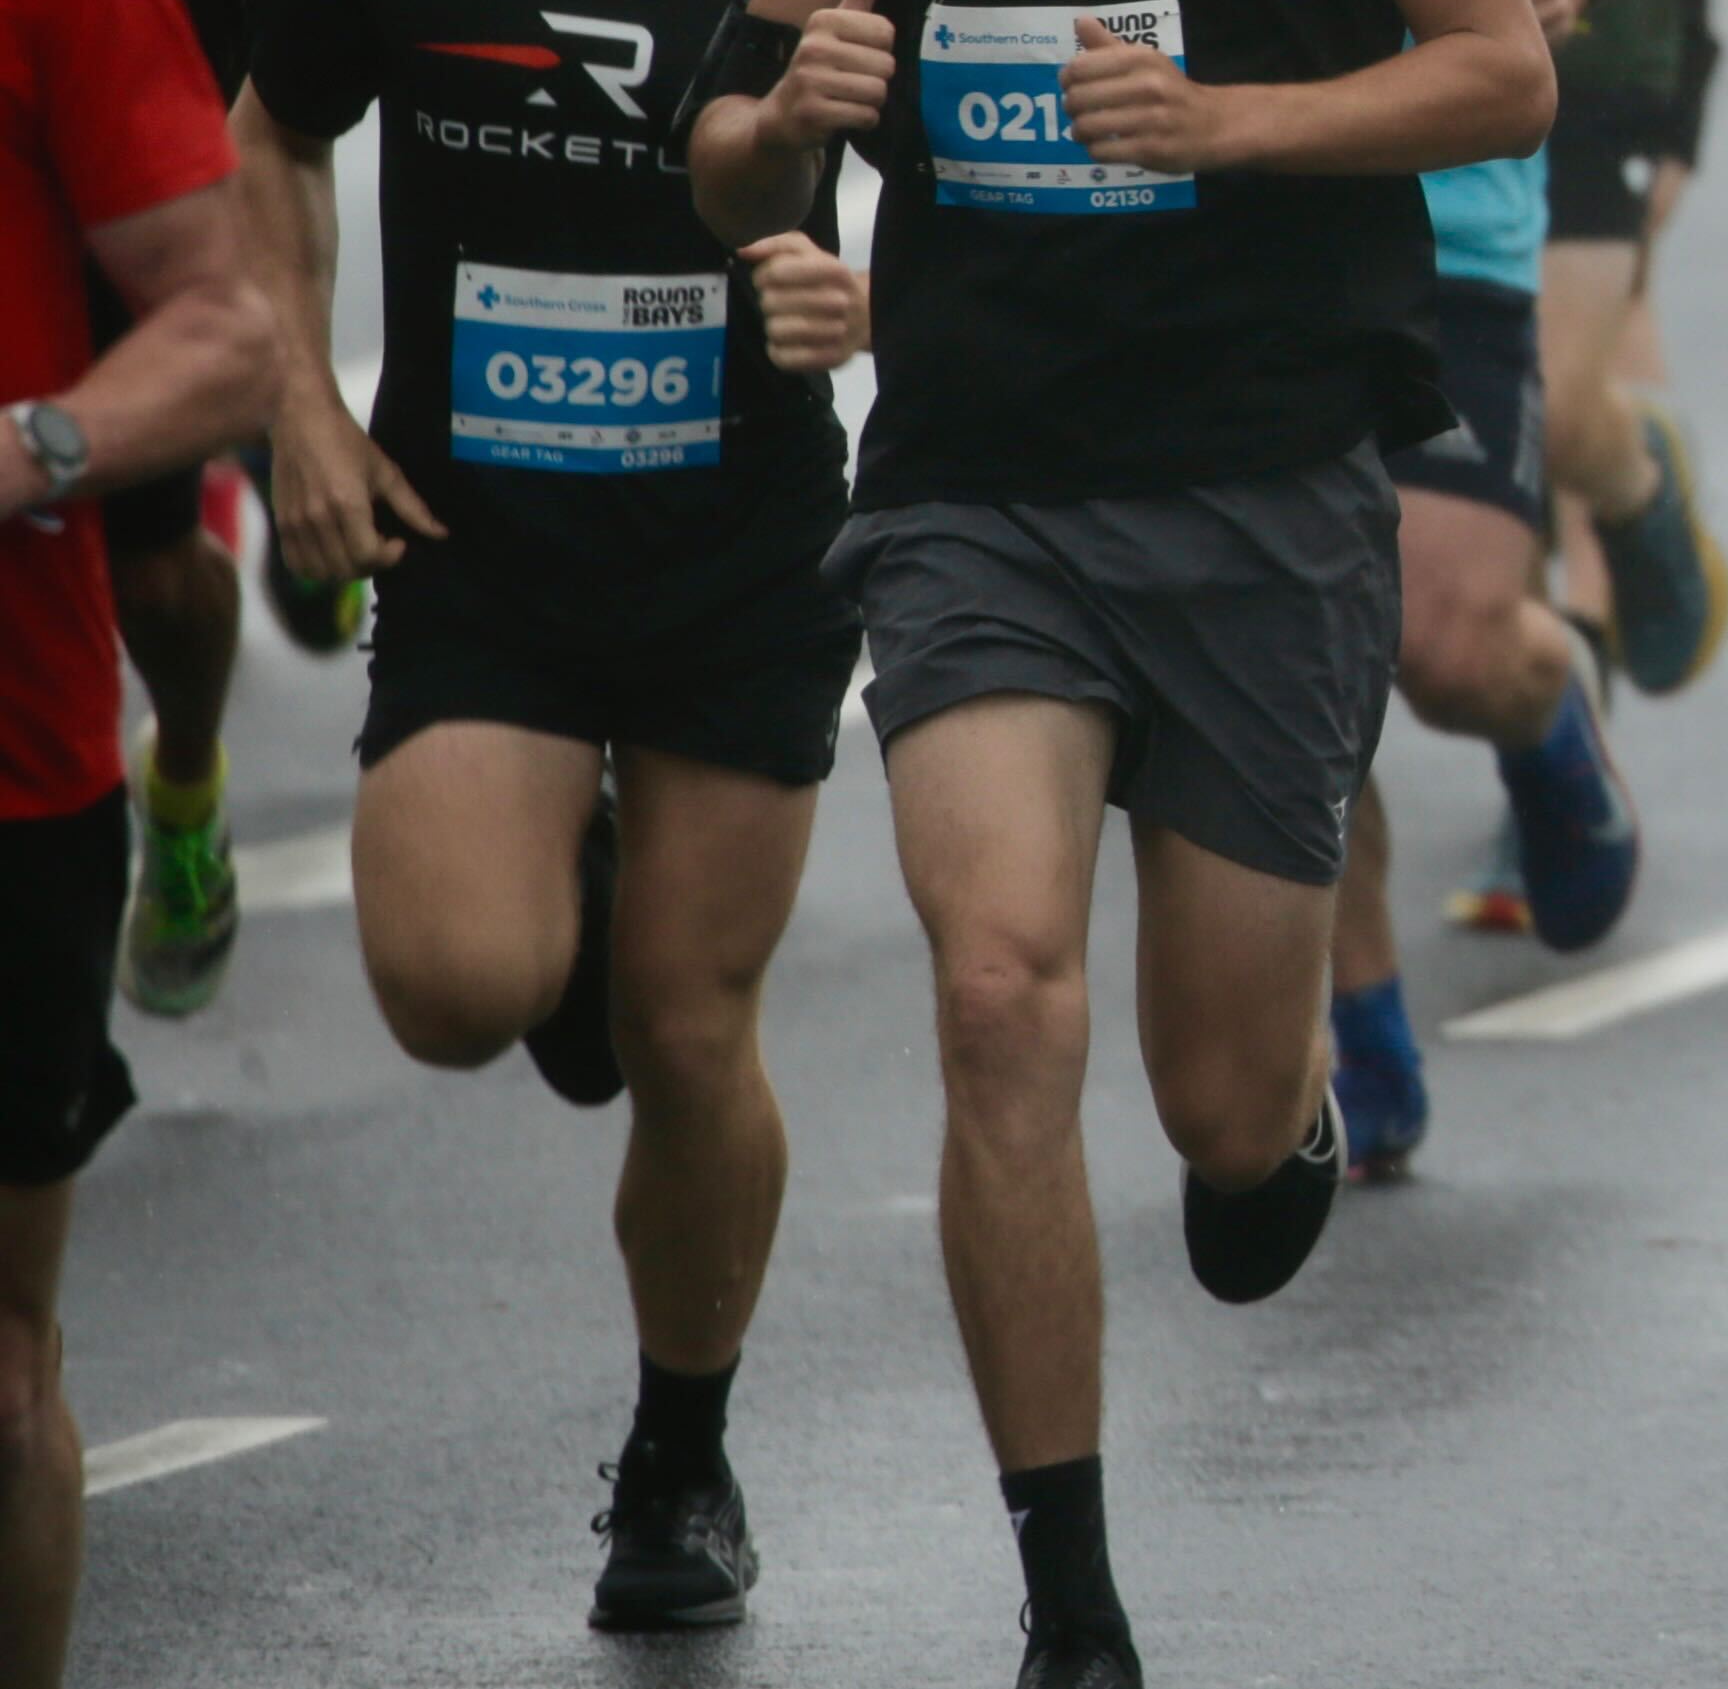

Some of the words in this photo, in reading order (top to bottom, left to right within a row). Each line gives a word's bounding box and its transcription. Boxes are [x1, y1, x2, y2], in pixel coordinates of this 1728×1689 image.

[959, 31, 1018, 45] Southern
[1021, 33, 1058, 45] Cross
[1007, 191, 1034, 205] TAG
[1090, 188, 1155, 208] 02130
[504, 293, 566, 311] Southern
[623, 286, 704, 305] ROUND
[633, 304, 703, 327] BAYS
[485, 350, 689, 407] 03296
[491, 446, 531, 460] GEAR
[536, 447, 564, 463] TAG
